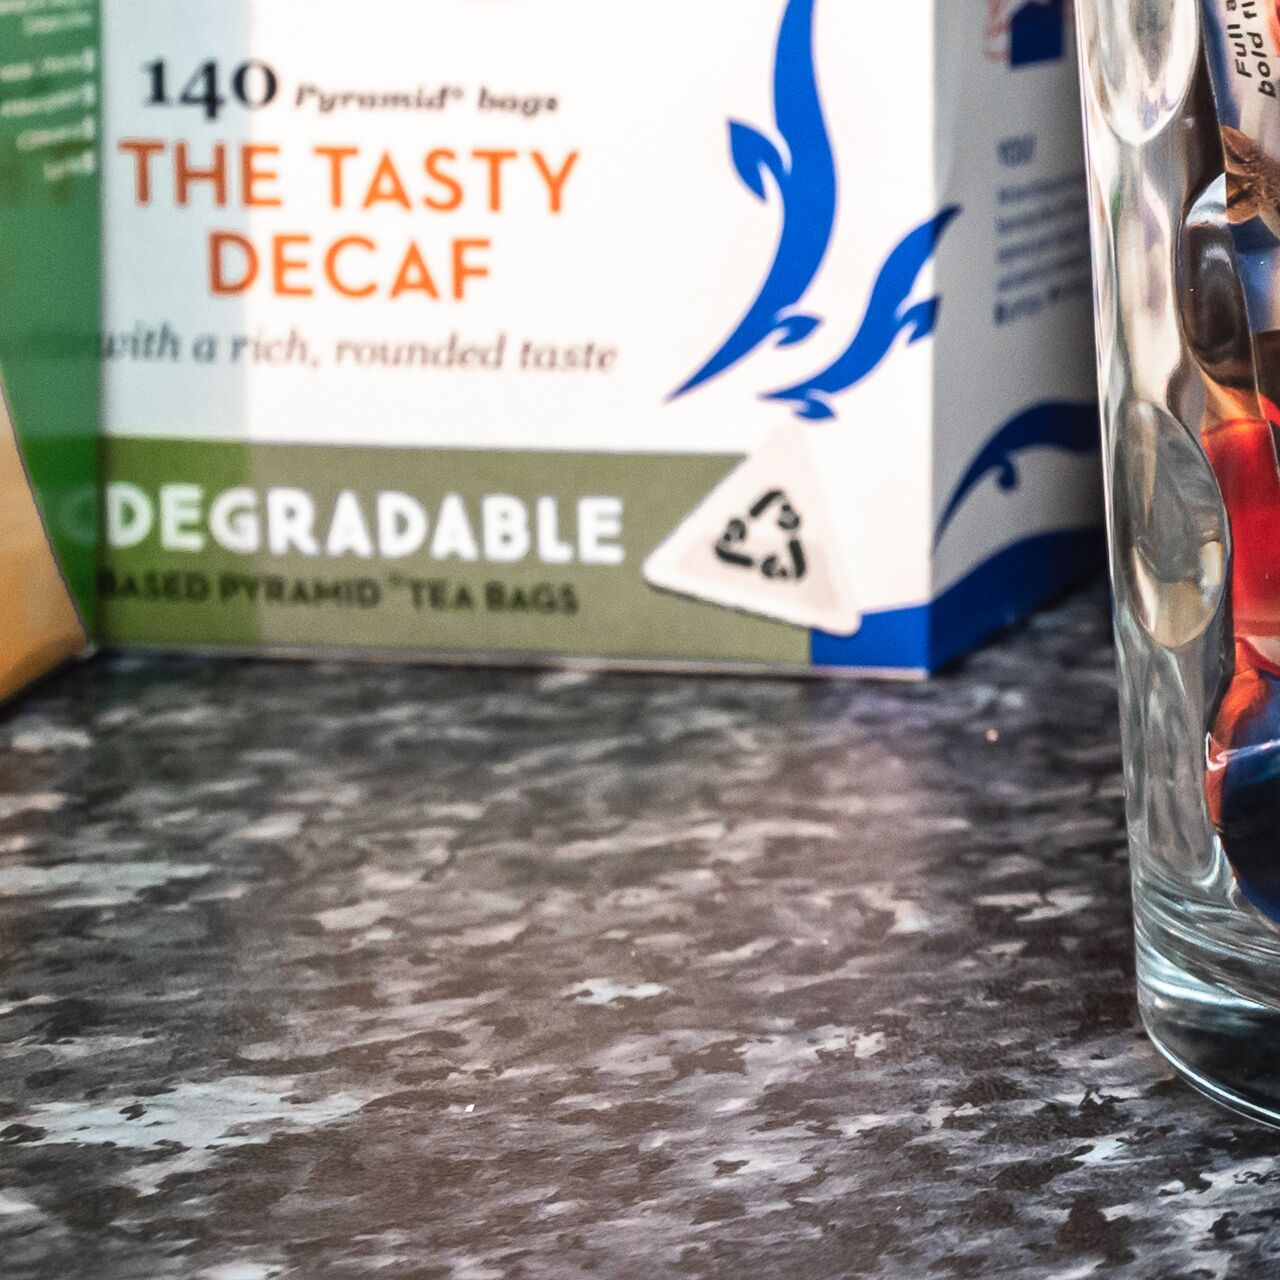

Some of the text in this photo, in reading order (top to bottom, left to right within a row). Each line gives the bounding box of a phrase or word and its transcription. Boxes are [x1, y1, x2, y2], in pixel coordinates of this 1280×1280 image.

[1227, 24, 1253, 78] Full
[1246, 32, 1276, 98] bold
[141, 57, 279, 121] 140
[476, 84, 560, 118] bags
[118, 138, 580, 213] THE TASTY
[207, 229, 493, 301] DECAF
[192, 333, 218, 365] a
[334, 332, 502, 371] rounded
[518, 332, 619, 373] taste
[484, 578, 580, 616] BAGS
